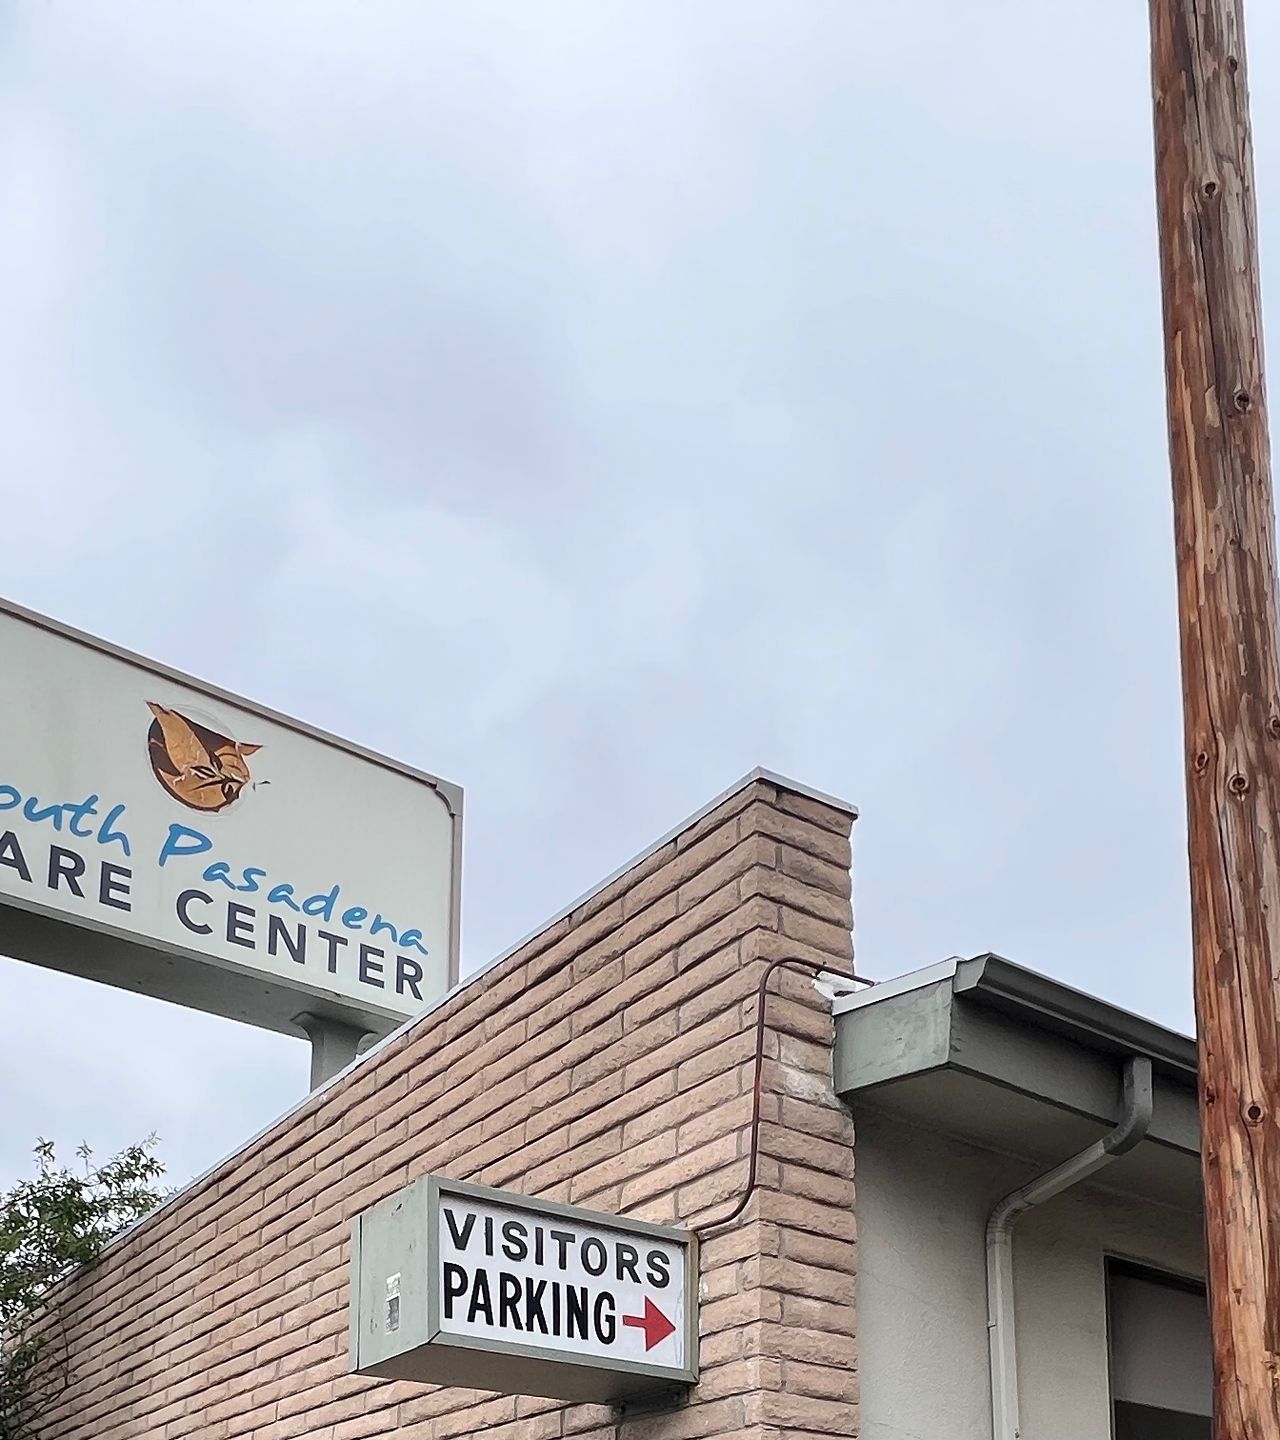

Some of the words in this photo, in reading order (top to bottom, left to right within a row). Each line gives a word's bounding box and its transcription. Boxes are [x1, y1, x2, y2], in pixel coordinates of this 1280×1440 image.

[158, 823, 428, 955] Pasadena
[176, 888, 424, 1001] CENTER
[443, 1208, 671, 1289] VISITORS
[443, 1261, 617, 1345] PARKING
